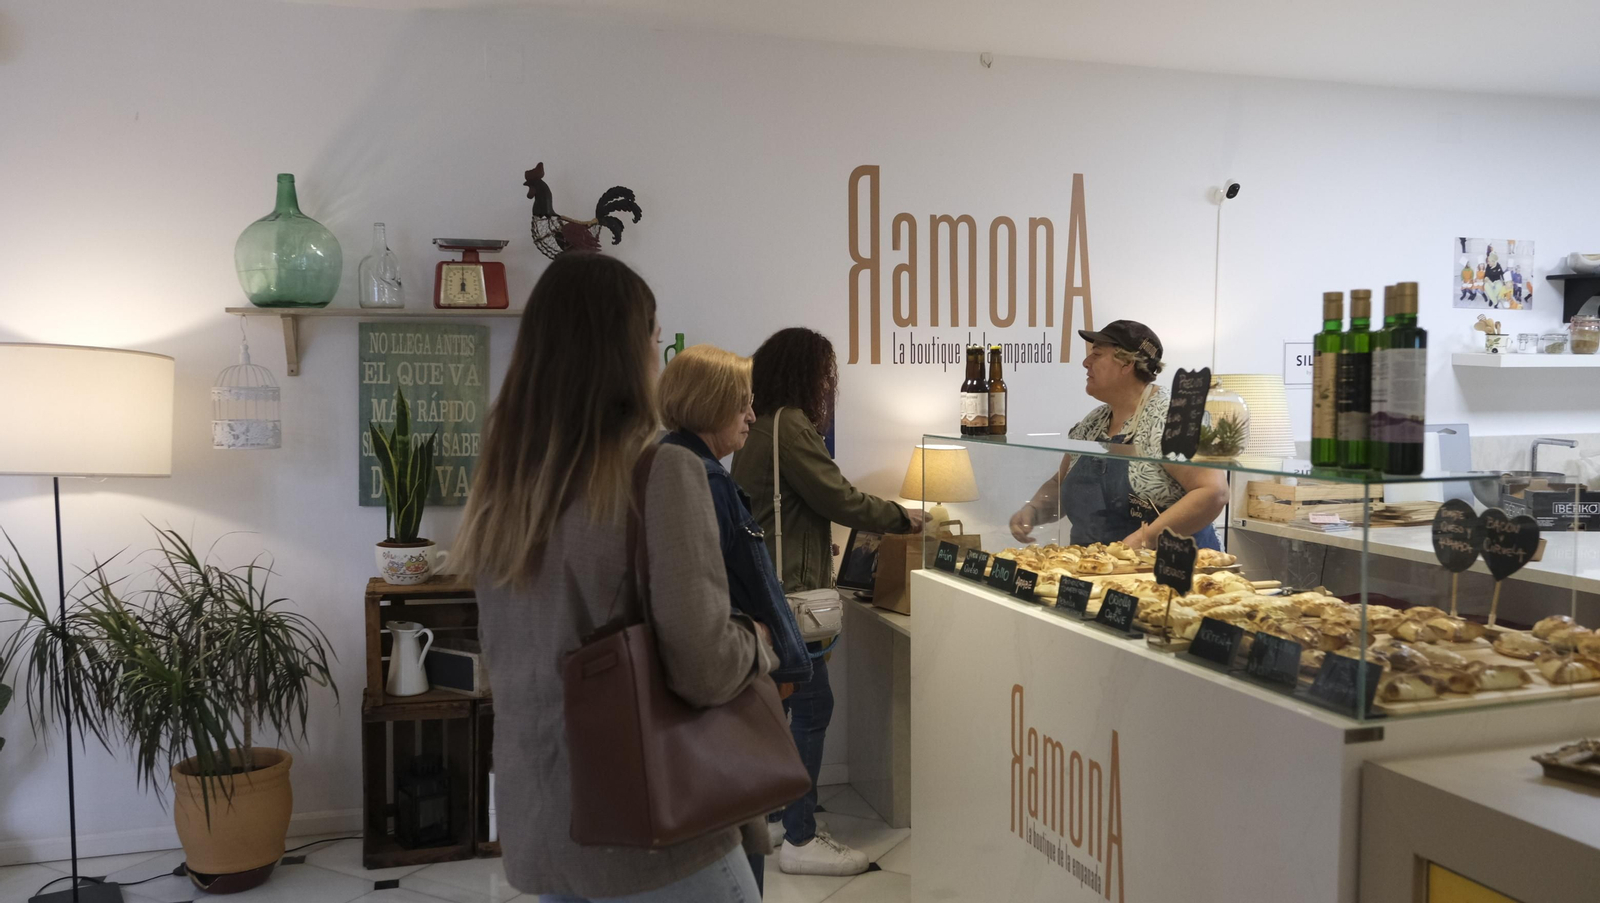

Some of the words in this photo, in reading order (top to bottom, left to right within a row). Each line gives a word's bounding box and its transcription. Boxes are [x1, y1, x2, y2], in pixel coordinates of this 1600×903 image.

[369, 332, 388, 354] NO
[391, 333, 432, 355] LLEGA
[434, 334, 475, 356] ANTES
[893, 332, 905, 364] La
[911, 332, 961, 372] boutique
[363, 362, 391, 384] EL
[397, 361, 444, 386] QUE
[448, 363, 481, 386] VA
[417, 391, 476, 422] RÁPIDO
[442, 432, 481, 457] SABE
[435, 466, 471, 498] VA
[1033, 821, 1056, 865] boutique
[1058, 838, 1064, 868] de
[1065, 843, 1071, 873] la
[1072, 859, 1101, 895] empanada
